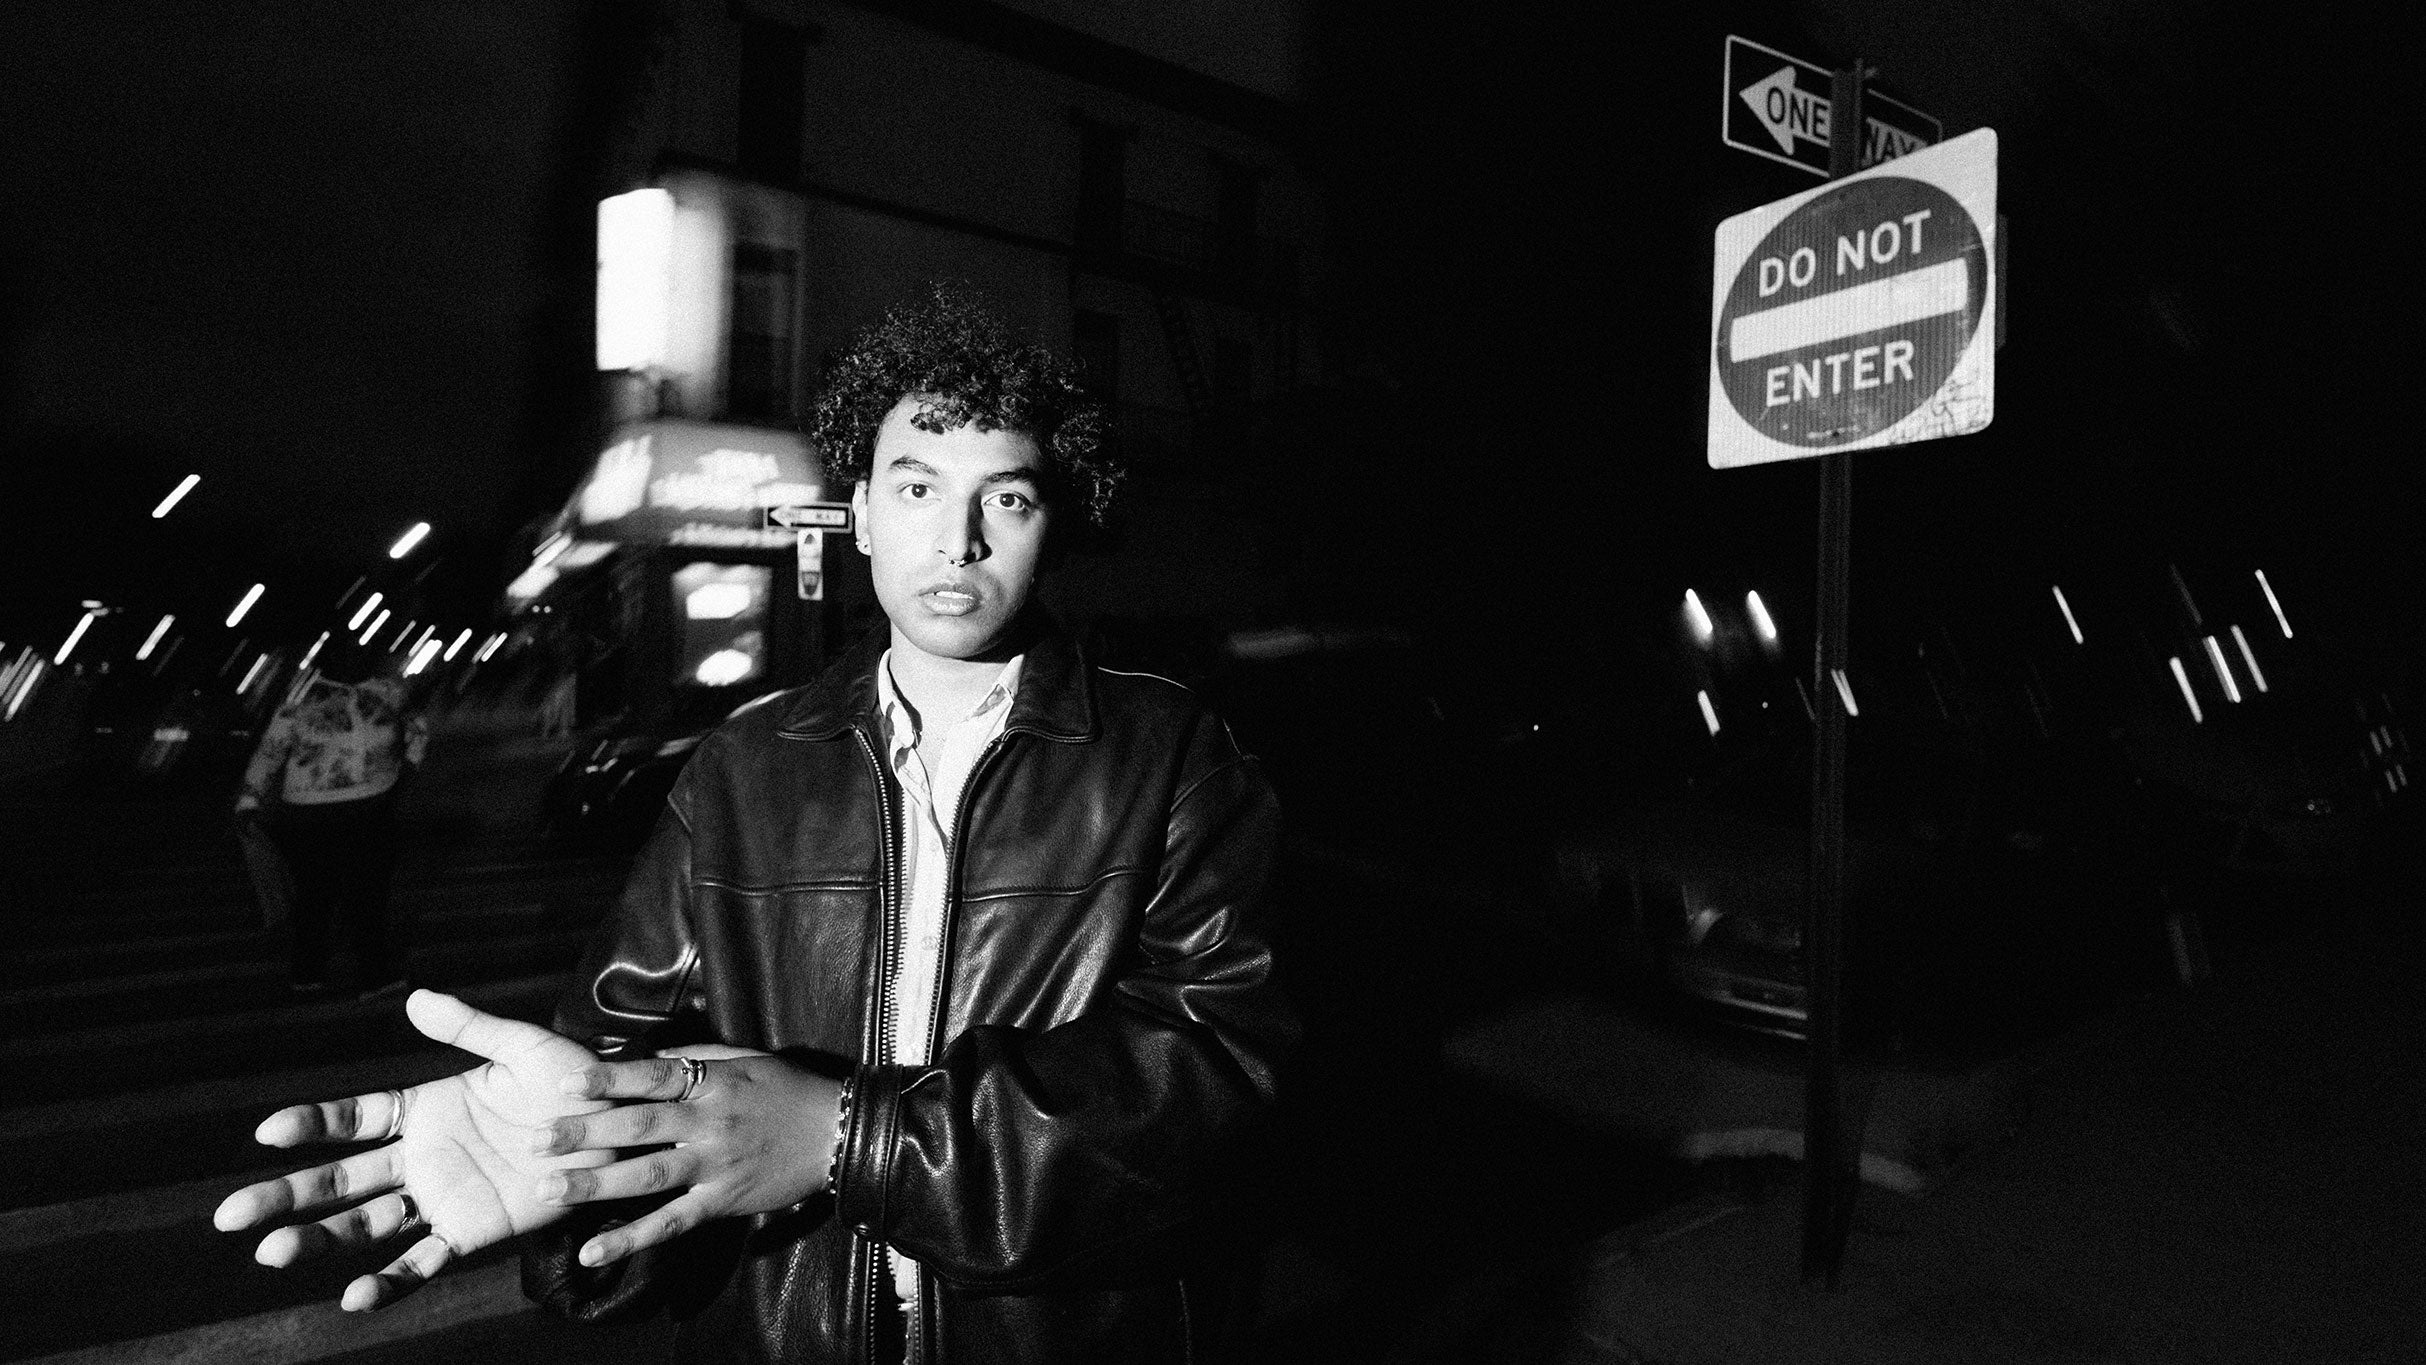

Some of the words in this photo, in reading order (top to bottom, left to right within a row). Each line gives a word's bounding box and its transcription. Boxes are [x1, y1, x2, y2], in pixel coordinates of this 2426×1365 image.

[1767, 86, 1828, 138] ONE
[1759, 247, 1816, 297] DO
[1837, 208, 1931, 275] NOT
[1766, 340, 1914, 407] ENTER
